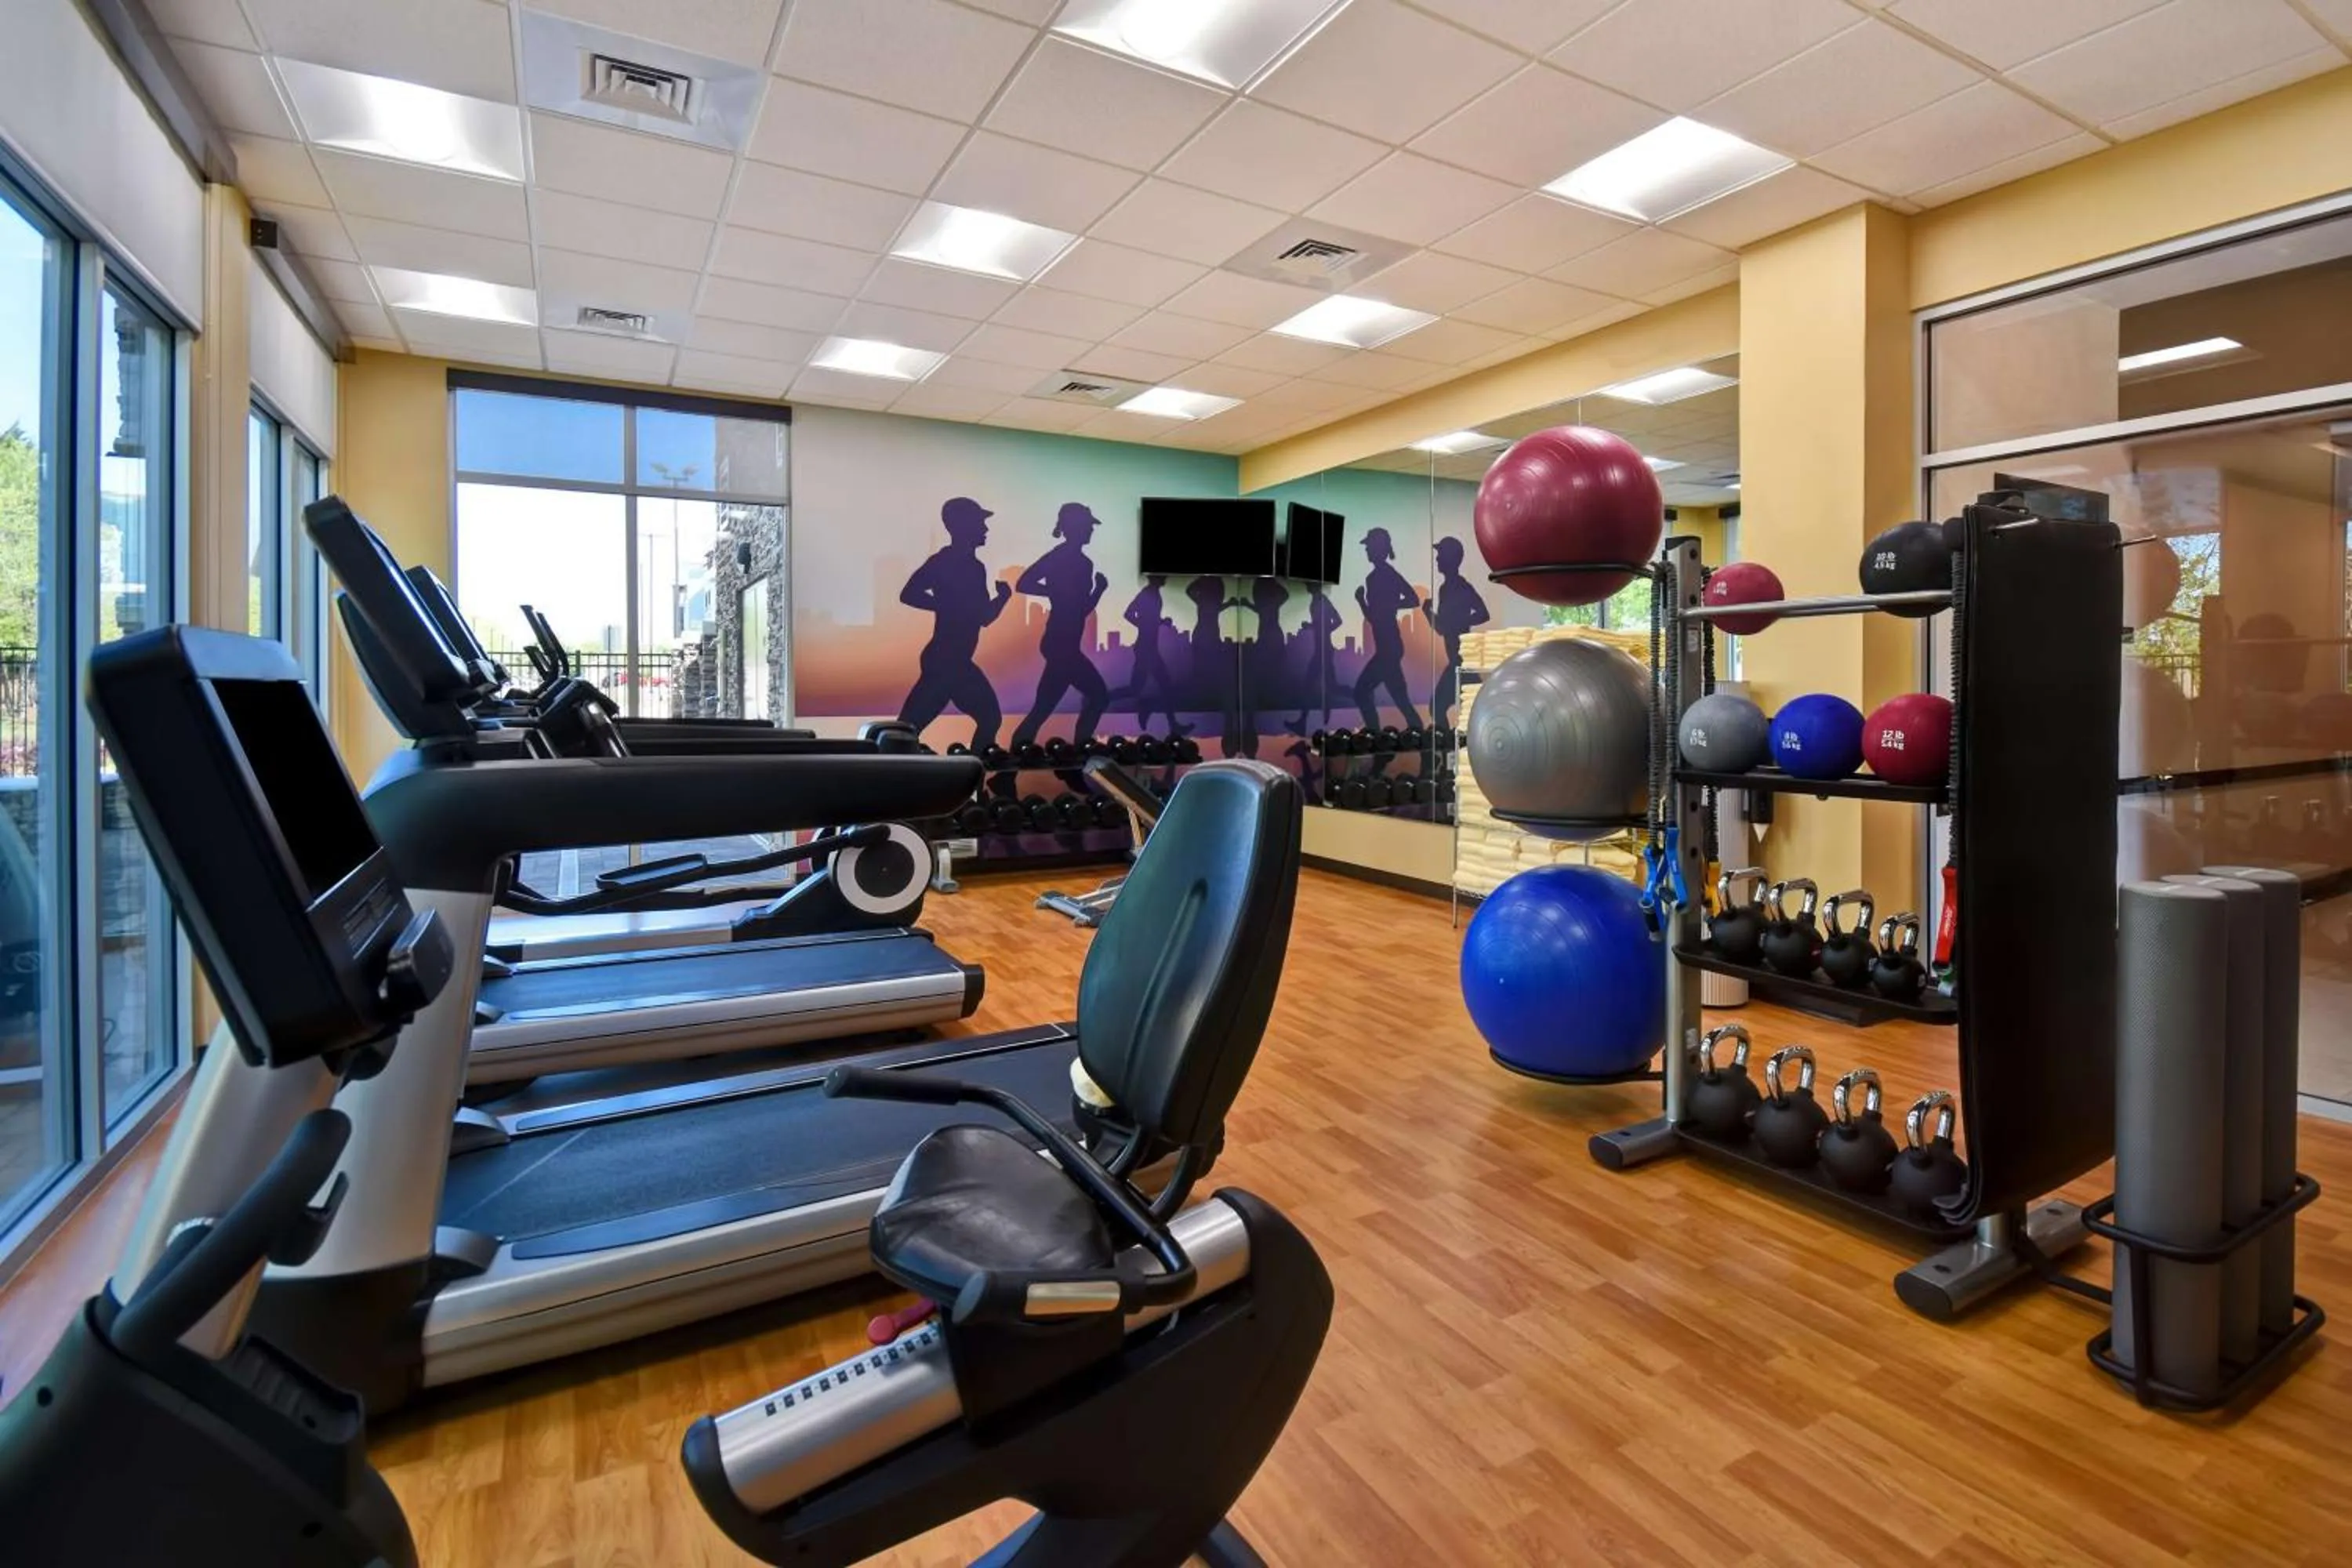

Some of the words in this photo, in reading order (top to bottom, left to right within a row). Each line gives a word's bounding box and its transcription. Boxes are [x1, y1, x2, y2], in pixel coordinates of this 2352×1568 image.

[1882, 730, 1894, 739] 12
[1895, 730, 1904, 739] lb
[1893, 739, 1904, 750] kg
